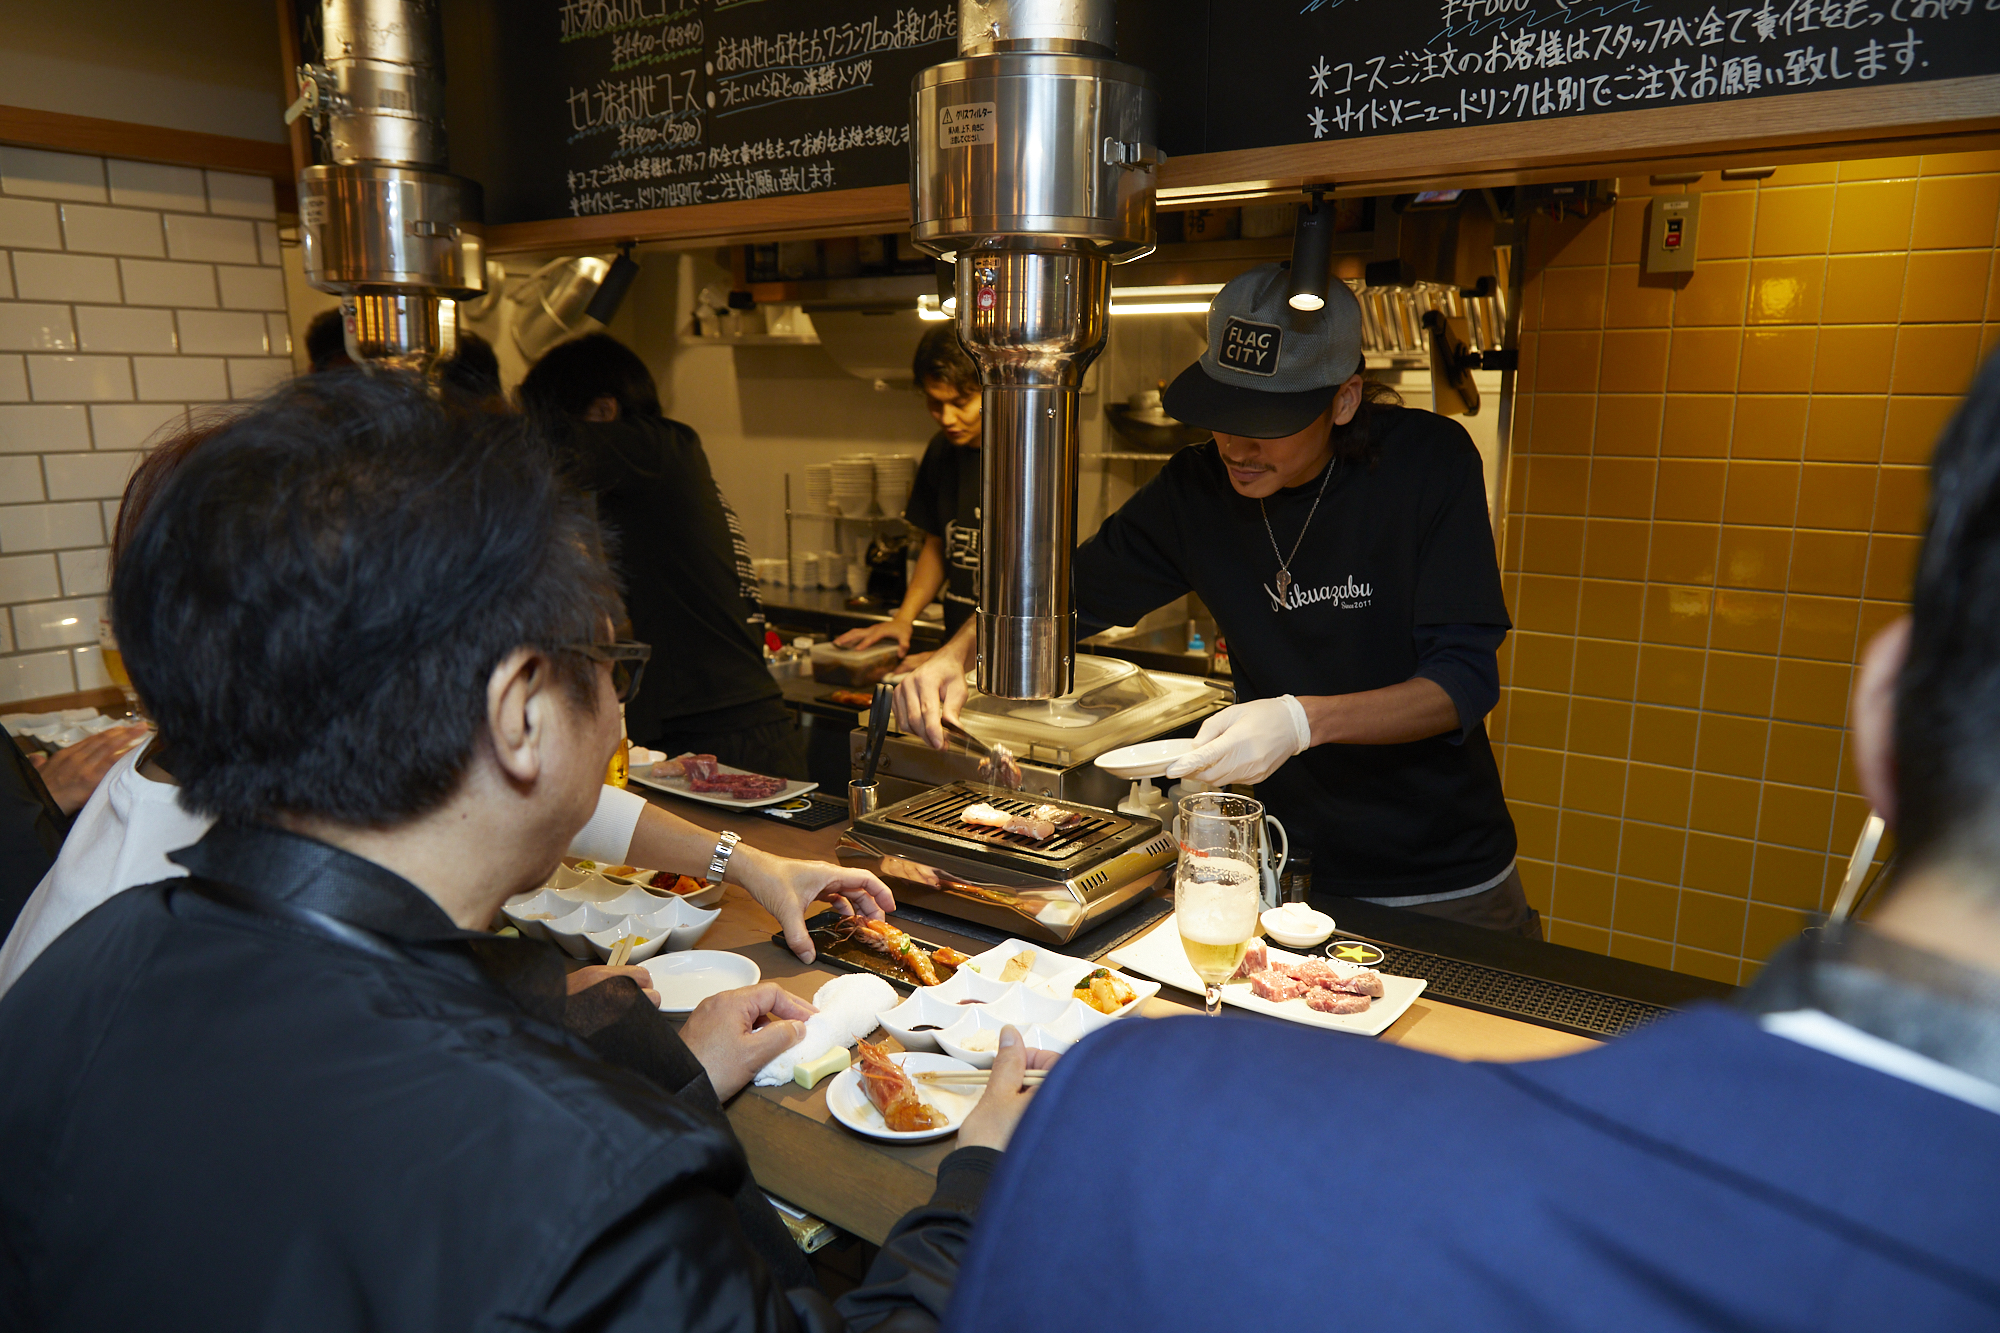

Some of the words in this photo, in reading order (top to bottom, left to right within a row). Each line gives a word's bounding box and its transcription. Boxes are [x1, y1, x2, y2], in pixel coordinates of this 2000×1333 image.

[956, 108, 993, 120] グリスフィルター
[1228, 326, 1272, 349] FLAG
[1226, 344, 1269, 366] CITY
[1263, 574, 1374, 613] Nikuazabu
